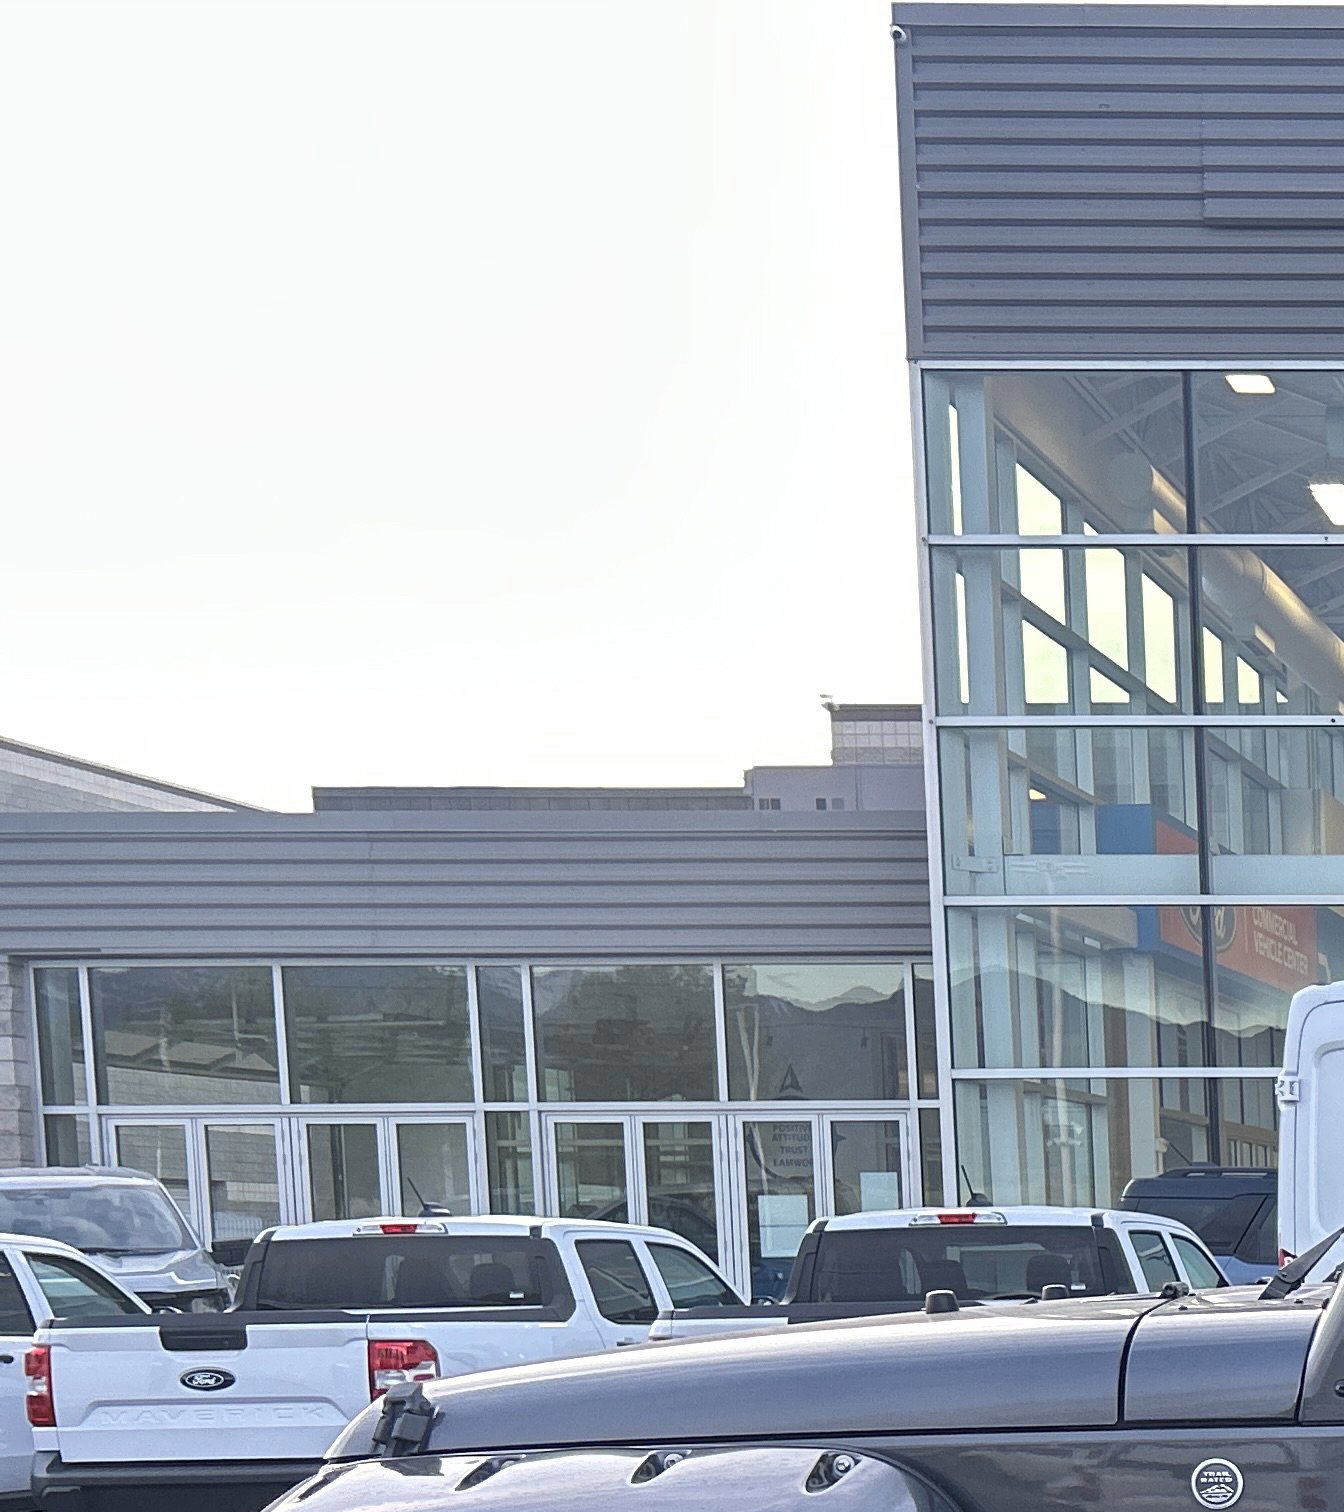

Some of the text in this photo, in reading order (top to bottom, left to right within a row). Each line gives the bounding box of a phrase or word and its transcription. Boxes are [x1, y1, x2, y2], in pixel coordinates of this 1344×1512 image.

[1254, 930, 1309, 976] VEHICLE CENTER
[102, 1407, 323, 1425] MAVERICK
